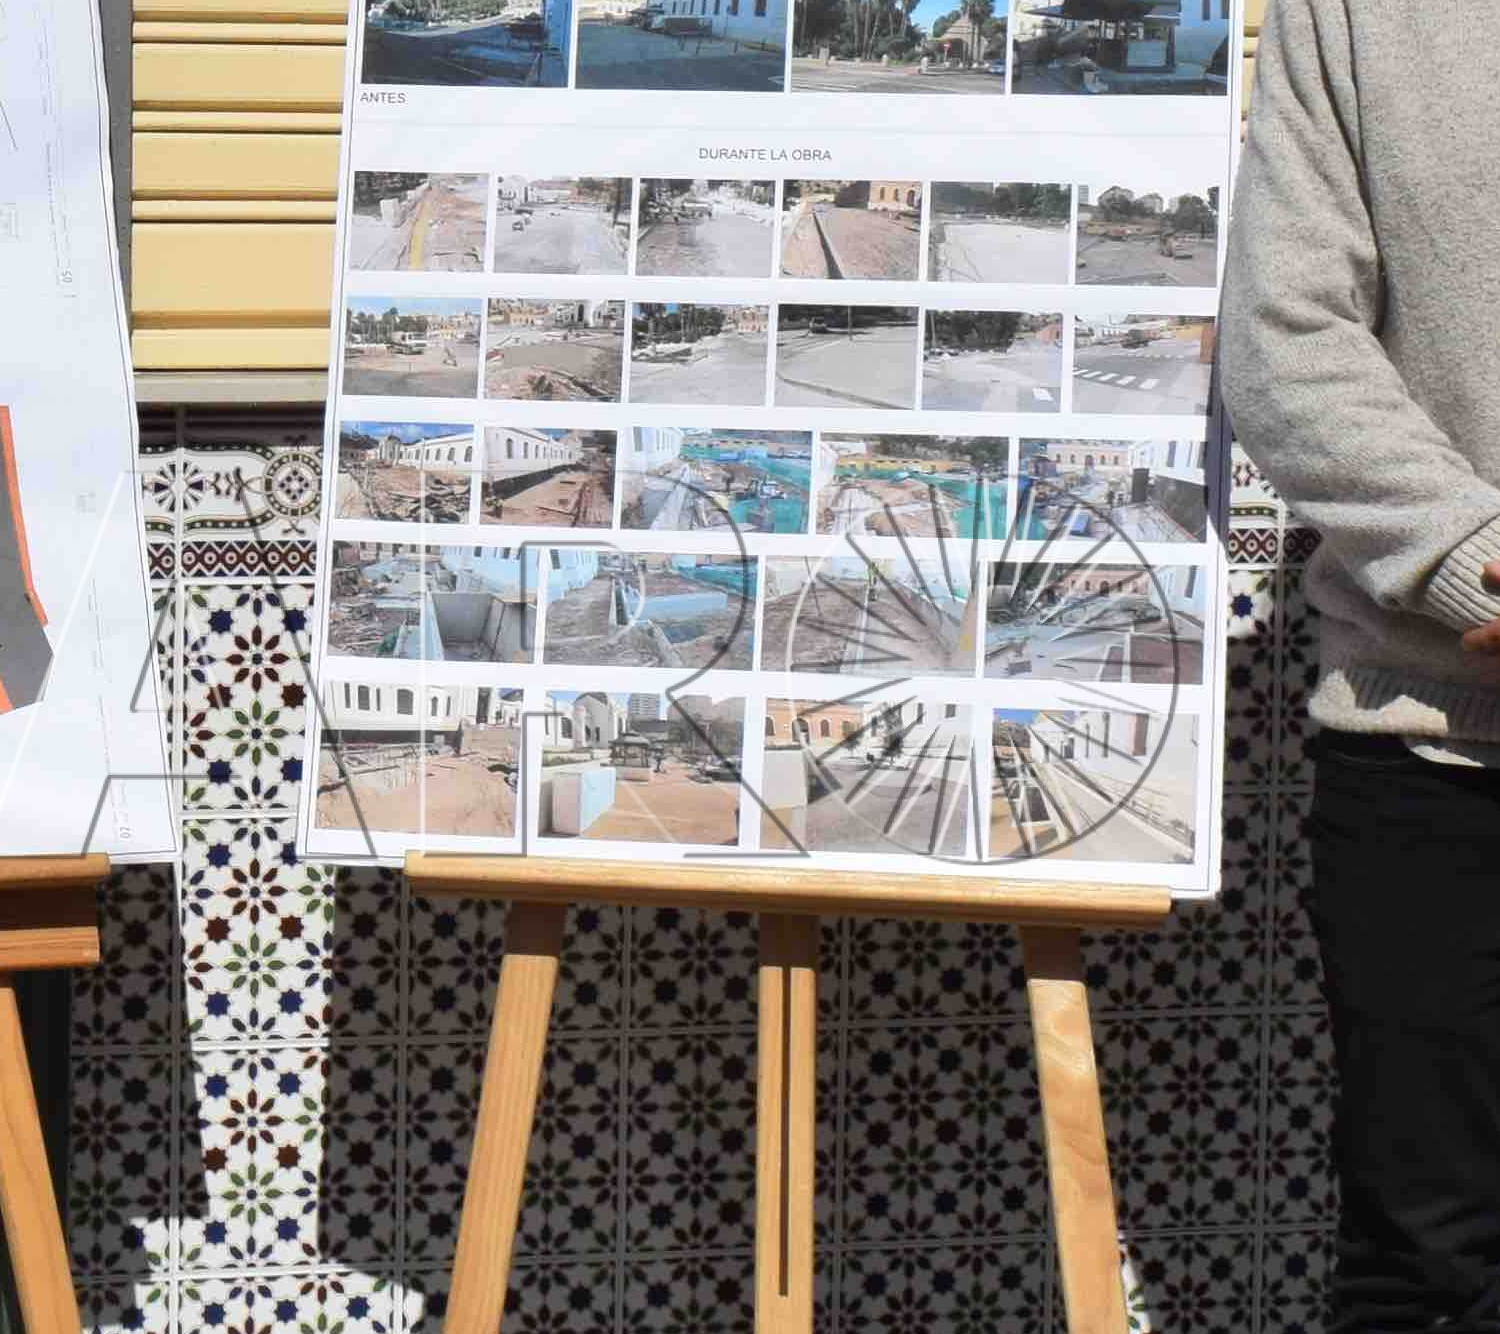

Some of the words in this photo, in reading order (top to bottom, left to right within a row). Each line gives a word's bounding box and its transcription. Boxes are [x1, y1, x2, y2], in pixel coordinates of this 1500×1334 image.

[360, 92, 406, 104] ANTES
[699, 148, 767, 160] DURANTE
[770, 149, 788, 161] LA
[791, 149, 833, 161] OBRA
